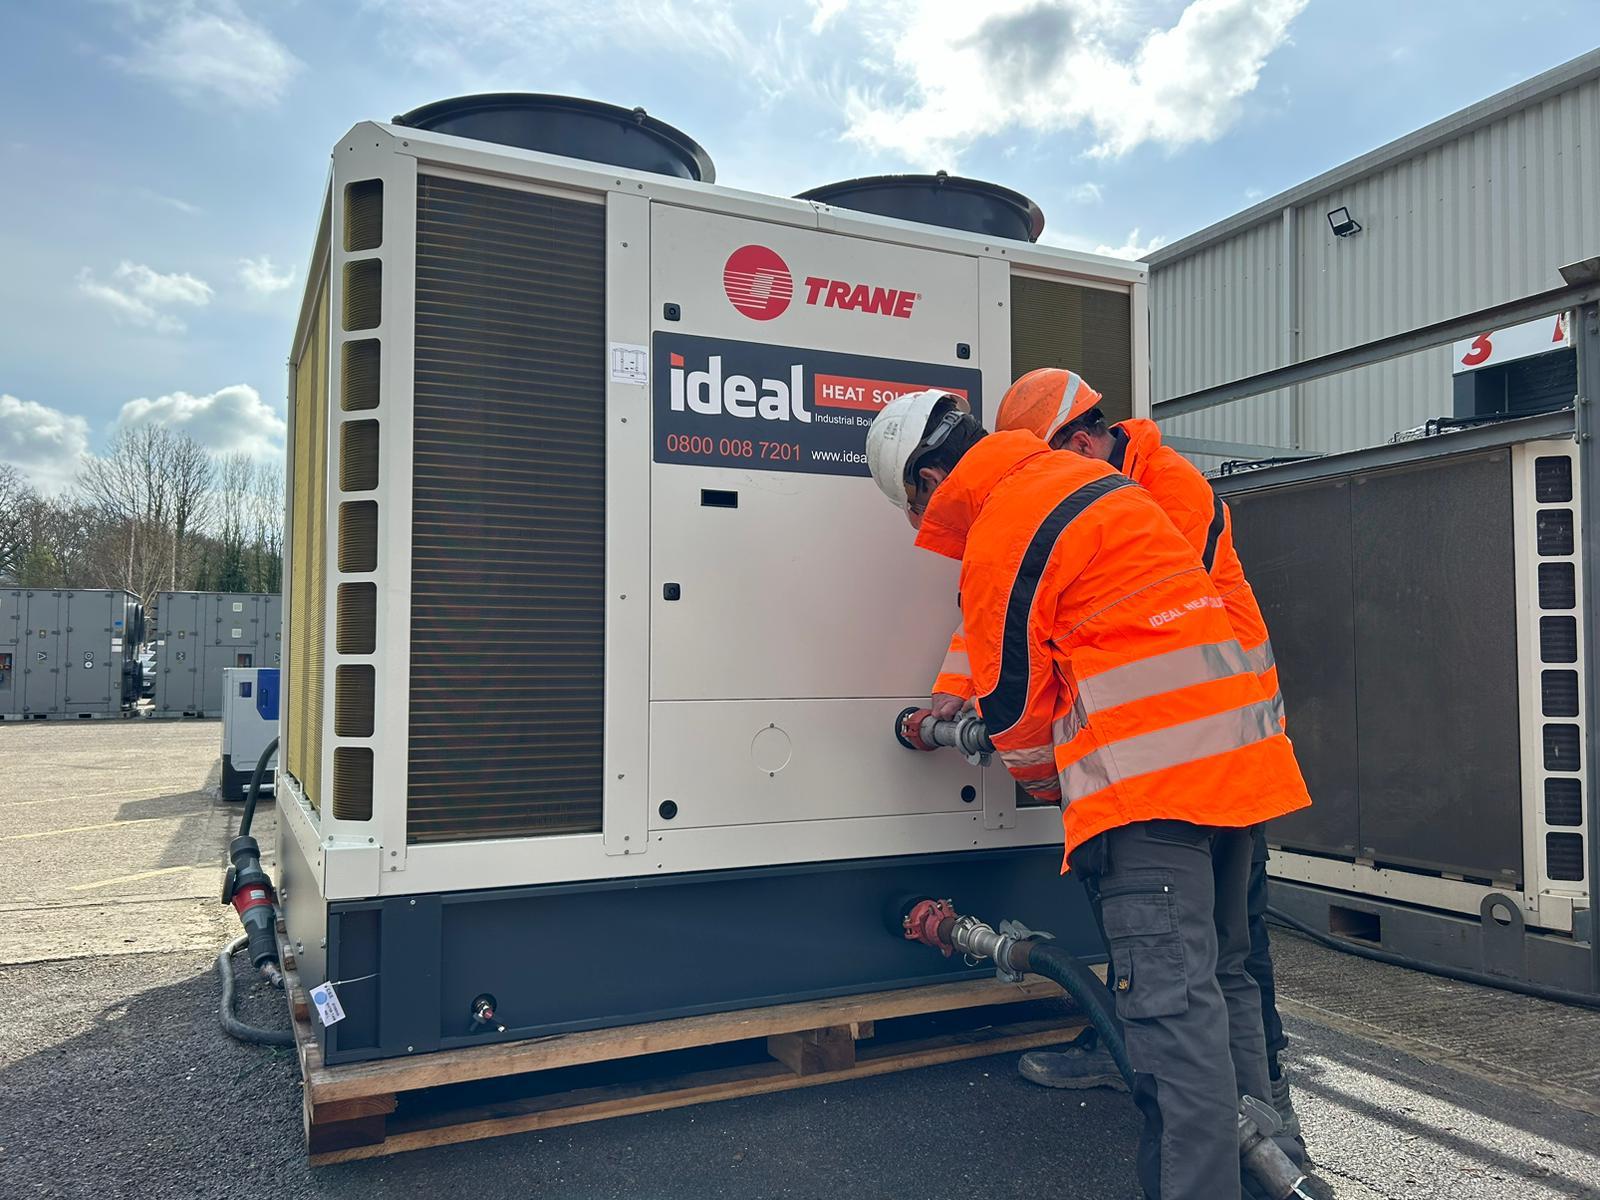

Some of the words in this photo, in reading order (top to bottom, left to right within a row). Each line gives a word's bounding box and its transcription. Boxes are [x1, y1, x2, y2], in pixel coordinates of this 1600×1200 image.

[670, 352, 811, 423] ideal
[822, 384, 865, 402] HEAT
[815, 413, 854, 425] Industrial
[856, 416, 873, 427] Boil
[667, 434, 714, 455] 0800
[719, 438, 753, 458] 008
[759, 441, 801, 461] 7201
[811, 450, 867, 463] www.idea
[1148, 608, 1187, 628] IDEAL
